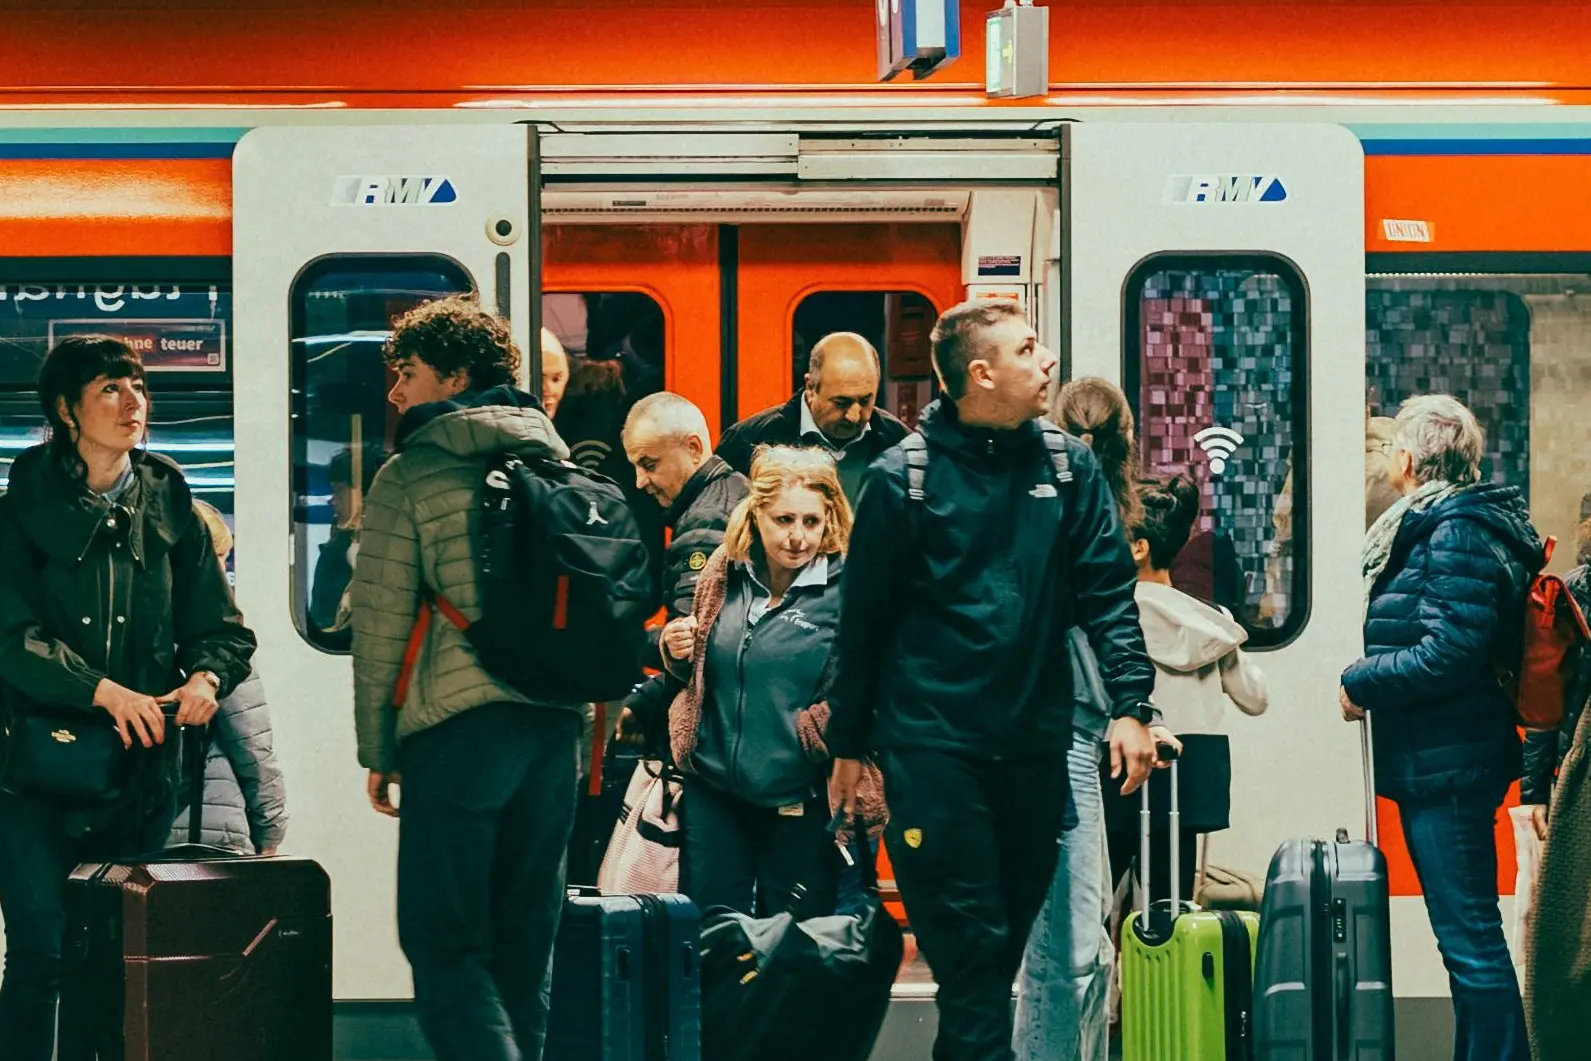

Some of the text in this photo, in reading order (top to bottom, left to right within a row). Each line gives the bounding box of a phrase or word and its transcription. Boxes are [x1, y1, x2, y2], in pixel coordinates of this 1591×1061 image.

[355, 177, 447, 204] RMV
[1185, 175, 1277, 203] RMV
[160, 337, 204, 351] teuer
